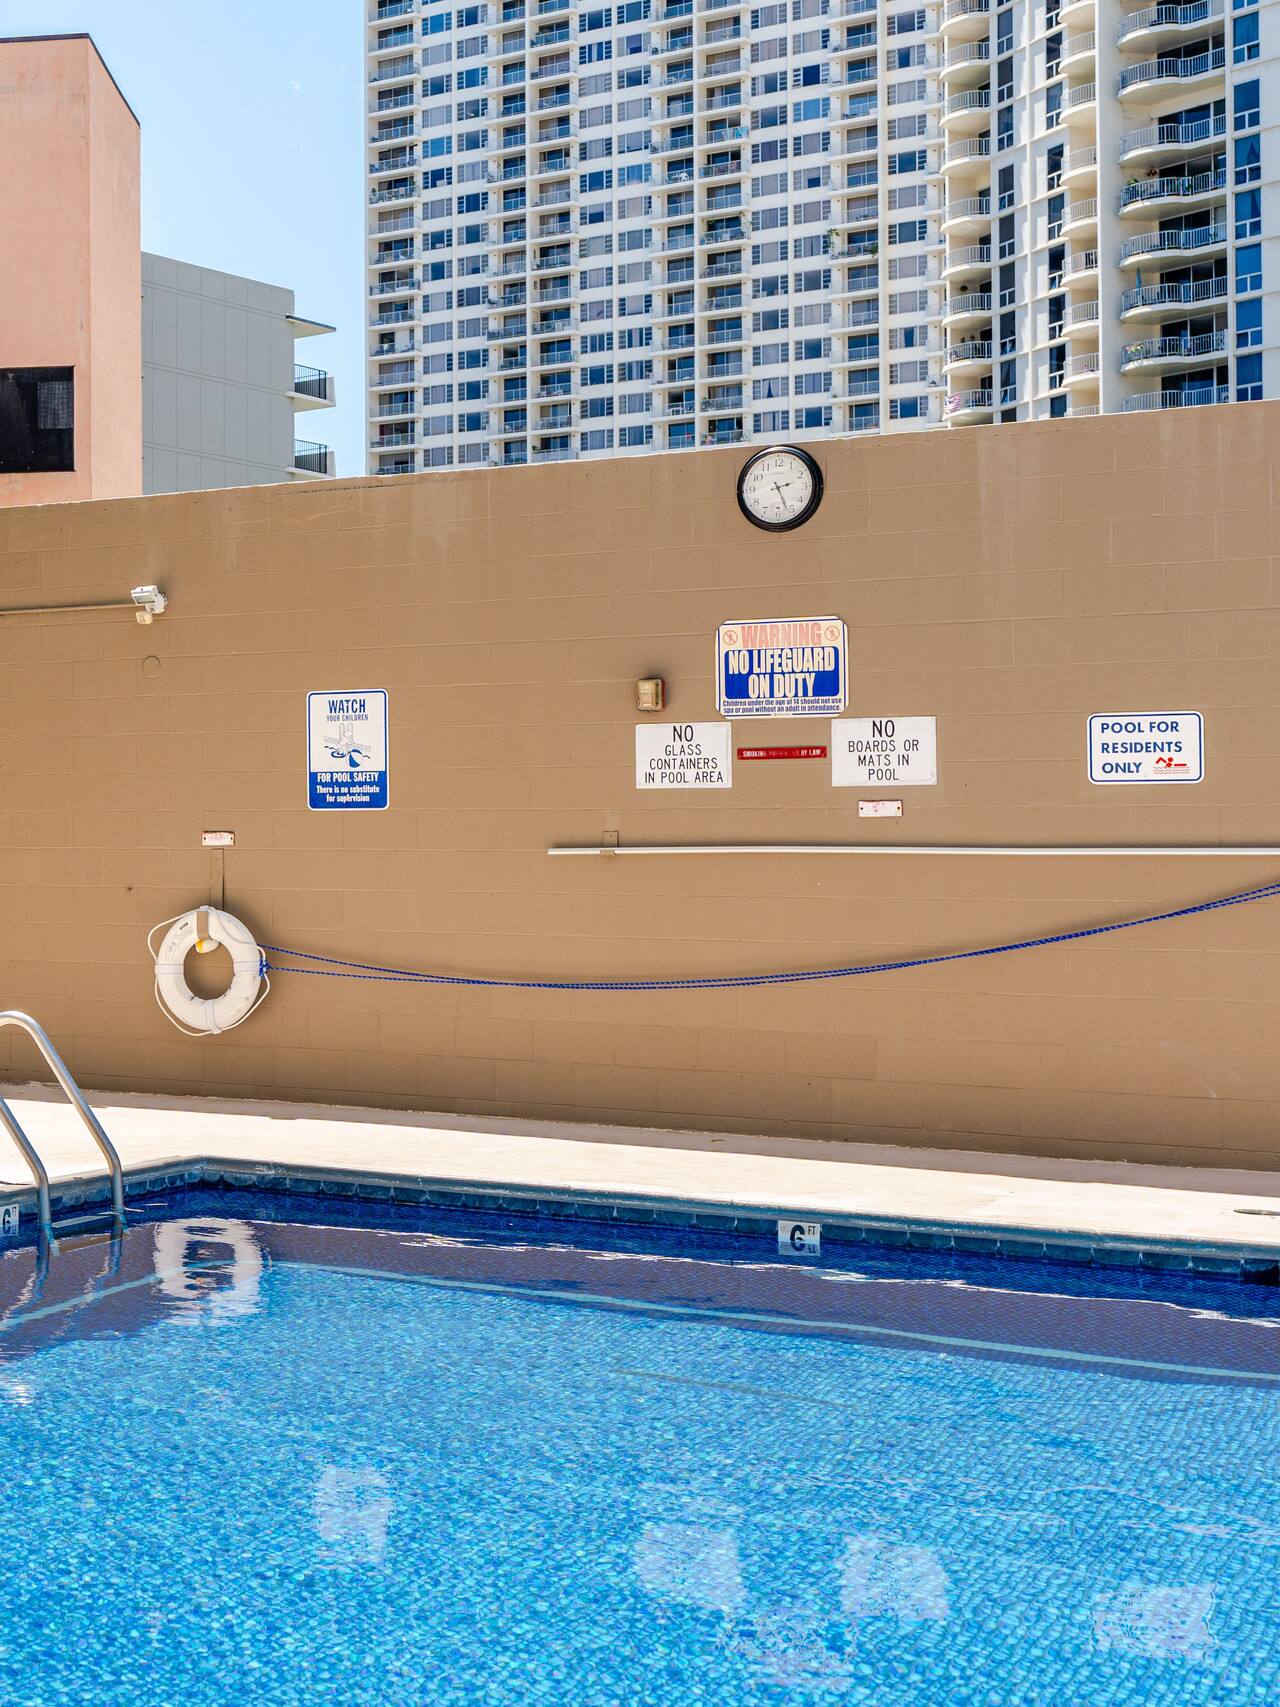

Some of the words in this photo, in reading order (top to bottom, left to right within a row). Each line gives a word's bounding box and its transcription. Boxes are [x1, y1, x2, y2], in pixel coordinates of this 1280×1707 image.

[762, 462, 770, 471] 11
[774, 458, 784, 467] 12
[753, 473, 763, 482] 10
[741, 623, 822, 649] WARNING
[728, 650, 749, 674] NO
[753, 647, 836, 673] LIFEGUARD
[748, 674, 770, 698] ON
[773, 673, 816, 698] DUTY
[328, 699, 365, 713] WATCH
[673, 725, 694, 742] NO
[872, 720, 895, 738] NO
[1101, 722, 1144, 734] POOL
[1149, 721, 1179, 732] FOR
[665, 744, 702, 756] GLASS
[848, 740, 896, 752] BOARDS
[904, 739, 919, 751] OR
[1101, 741, 1182, 754] RESIDENTS
[650, 758, 718, 770] CONTAINERS
[858, 754, 891, 766] MATS
[898, 754, 909, 766] IN
[1102, 762, 1142, 774] ONLY
[317, 773, 331, 782] FOR
[333, 772, 351, 782] POOL
[353, 772, 379, 782] SAFETY
[645, 772, 654, 783] IN
[661, 772, 689, 783] POOL
[694, 771, 723, 783] AREA
[868, 769, 899, 780] POOL
[316, 785, 333, 793] There
[334, 785, 339, 793] is
[350, 785, 379, 793] substitute
[326, 794, 335, 802] for
[337, 794, 369, 803] supervision
[808, 1226, 816, 1235] FT
